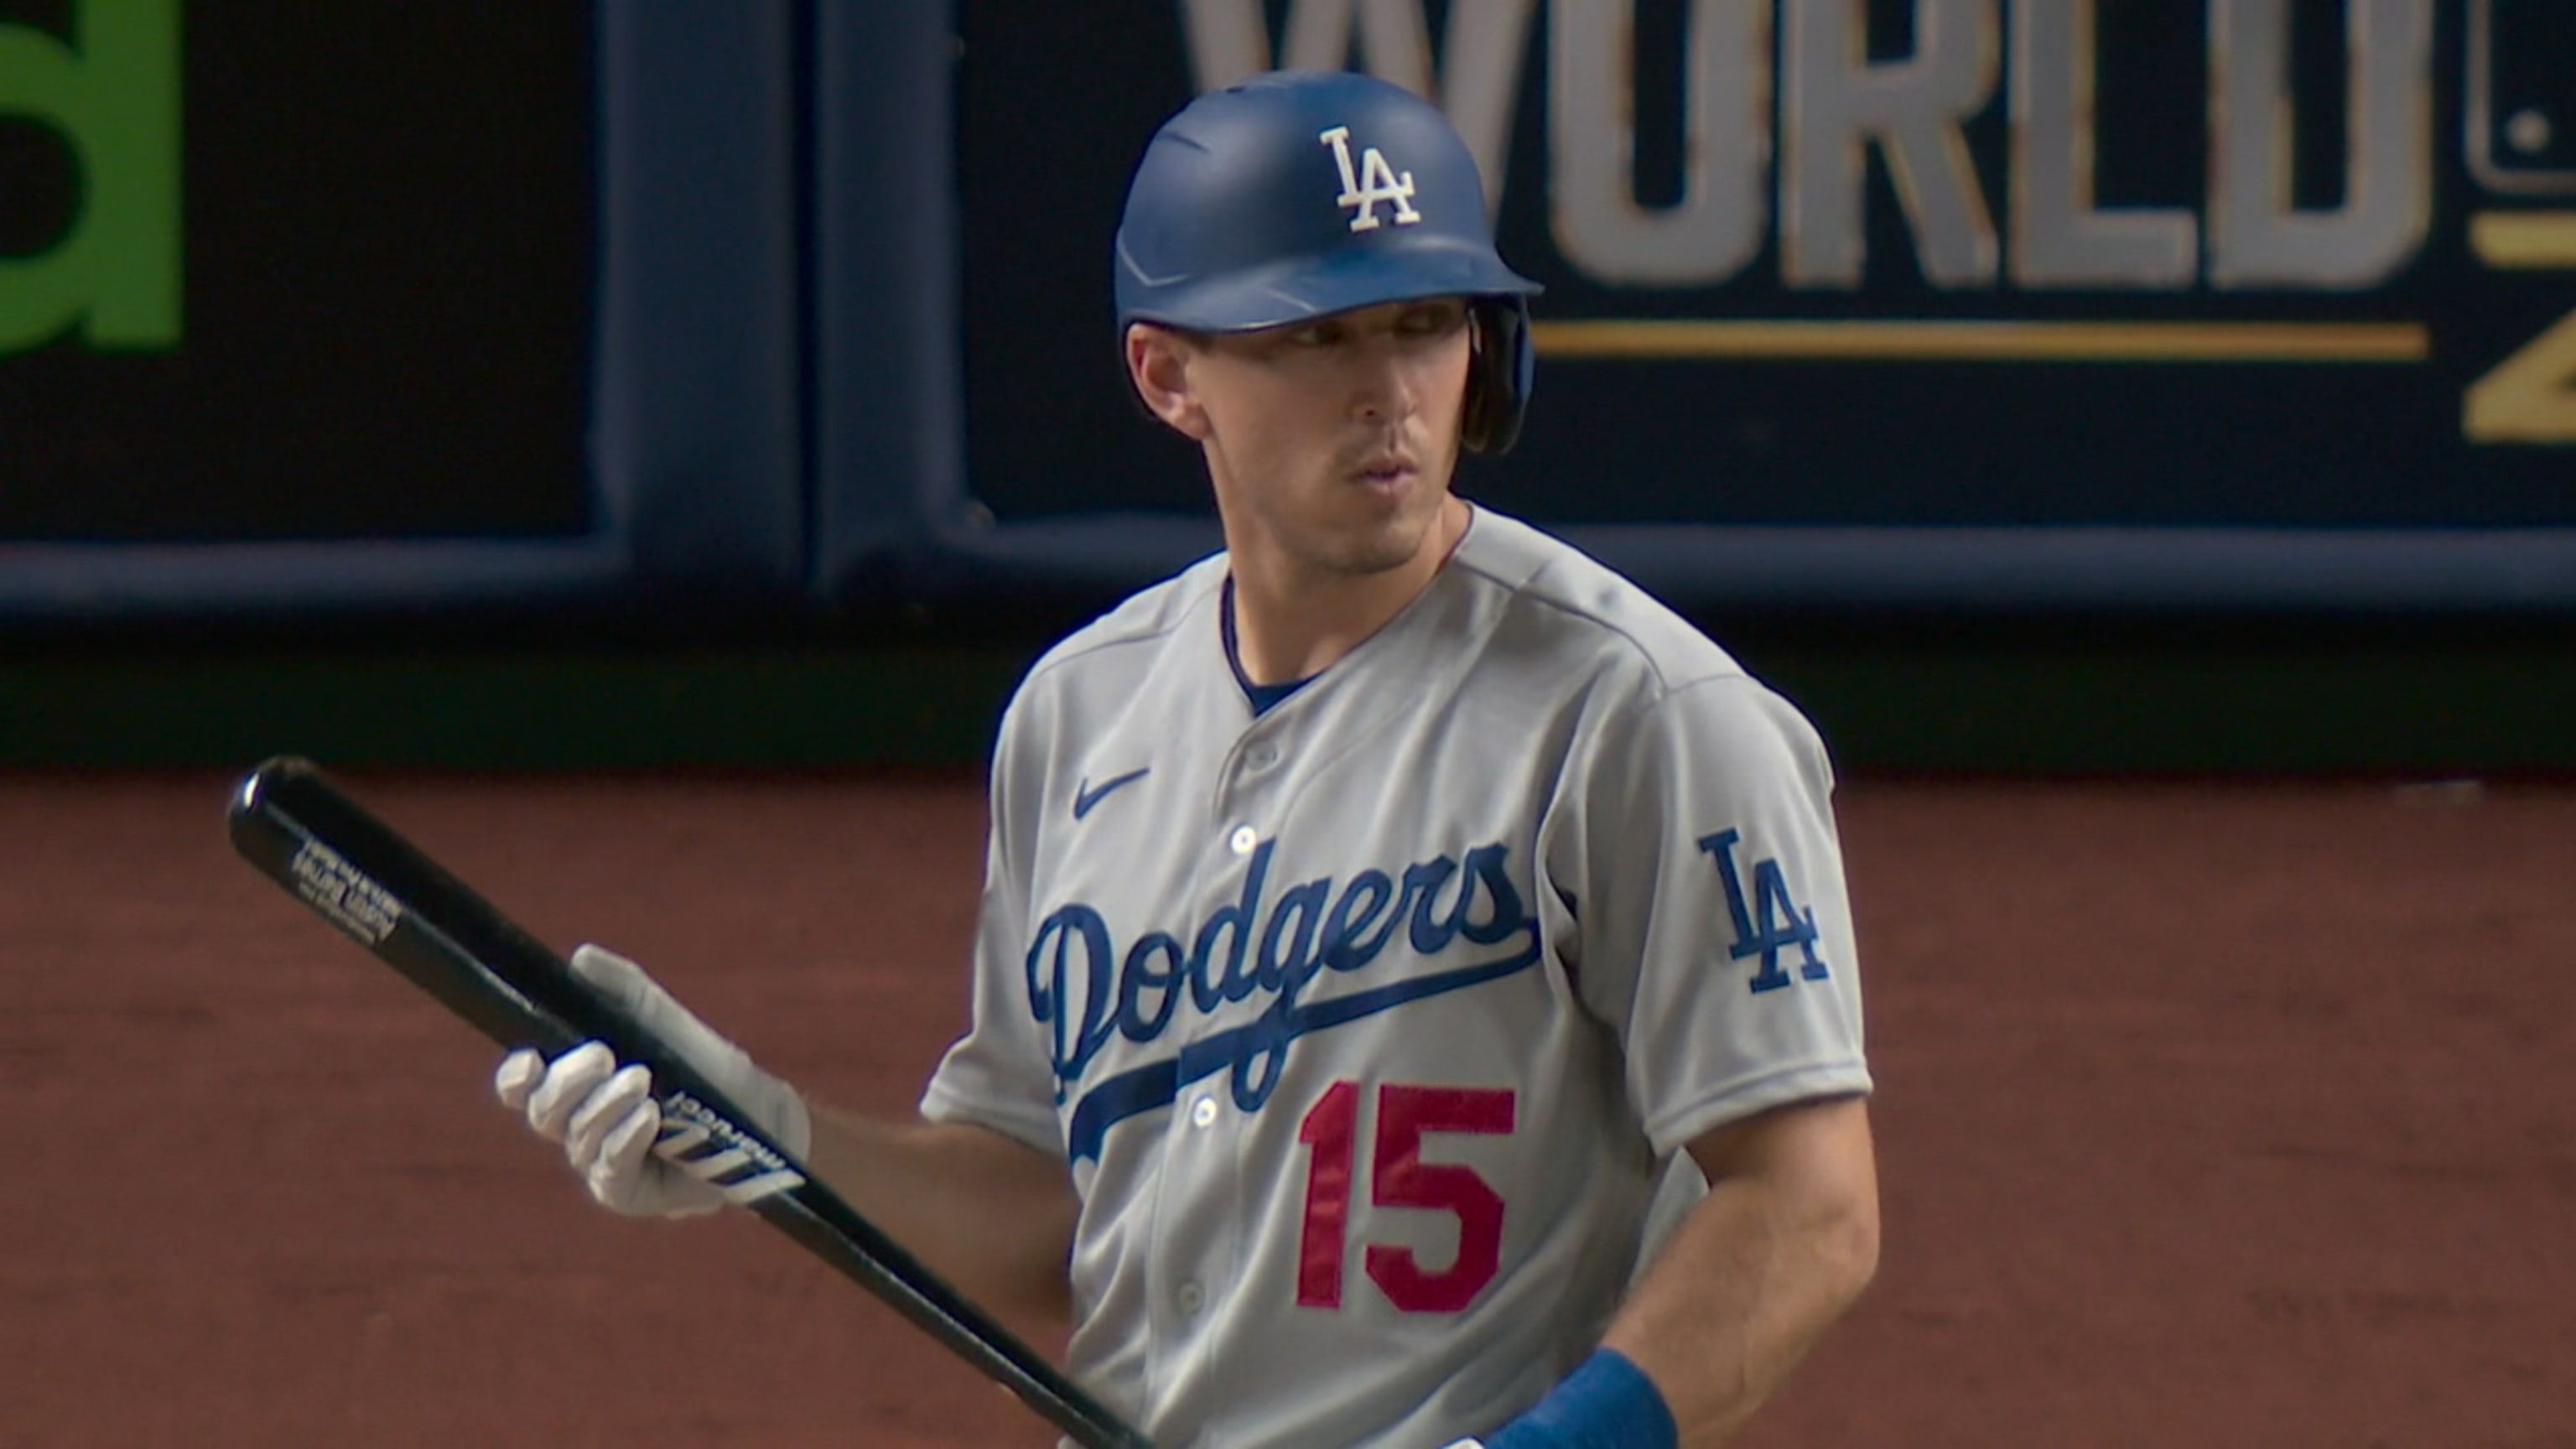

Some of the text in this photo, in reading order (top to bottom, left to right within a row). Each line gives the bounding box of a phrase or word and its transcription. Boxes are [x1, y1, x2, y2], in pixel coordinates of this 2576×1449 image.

[1320, 126, 1420, 232] LA
[1026, 837, 1530, 1113] Dodgers
[1697, 826, 1830, 994] LA
[1296, 1080, 1515, 1313] 15
